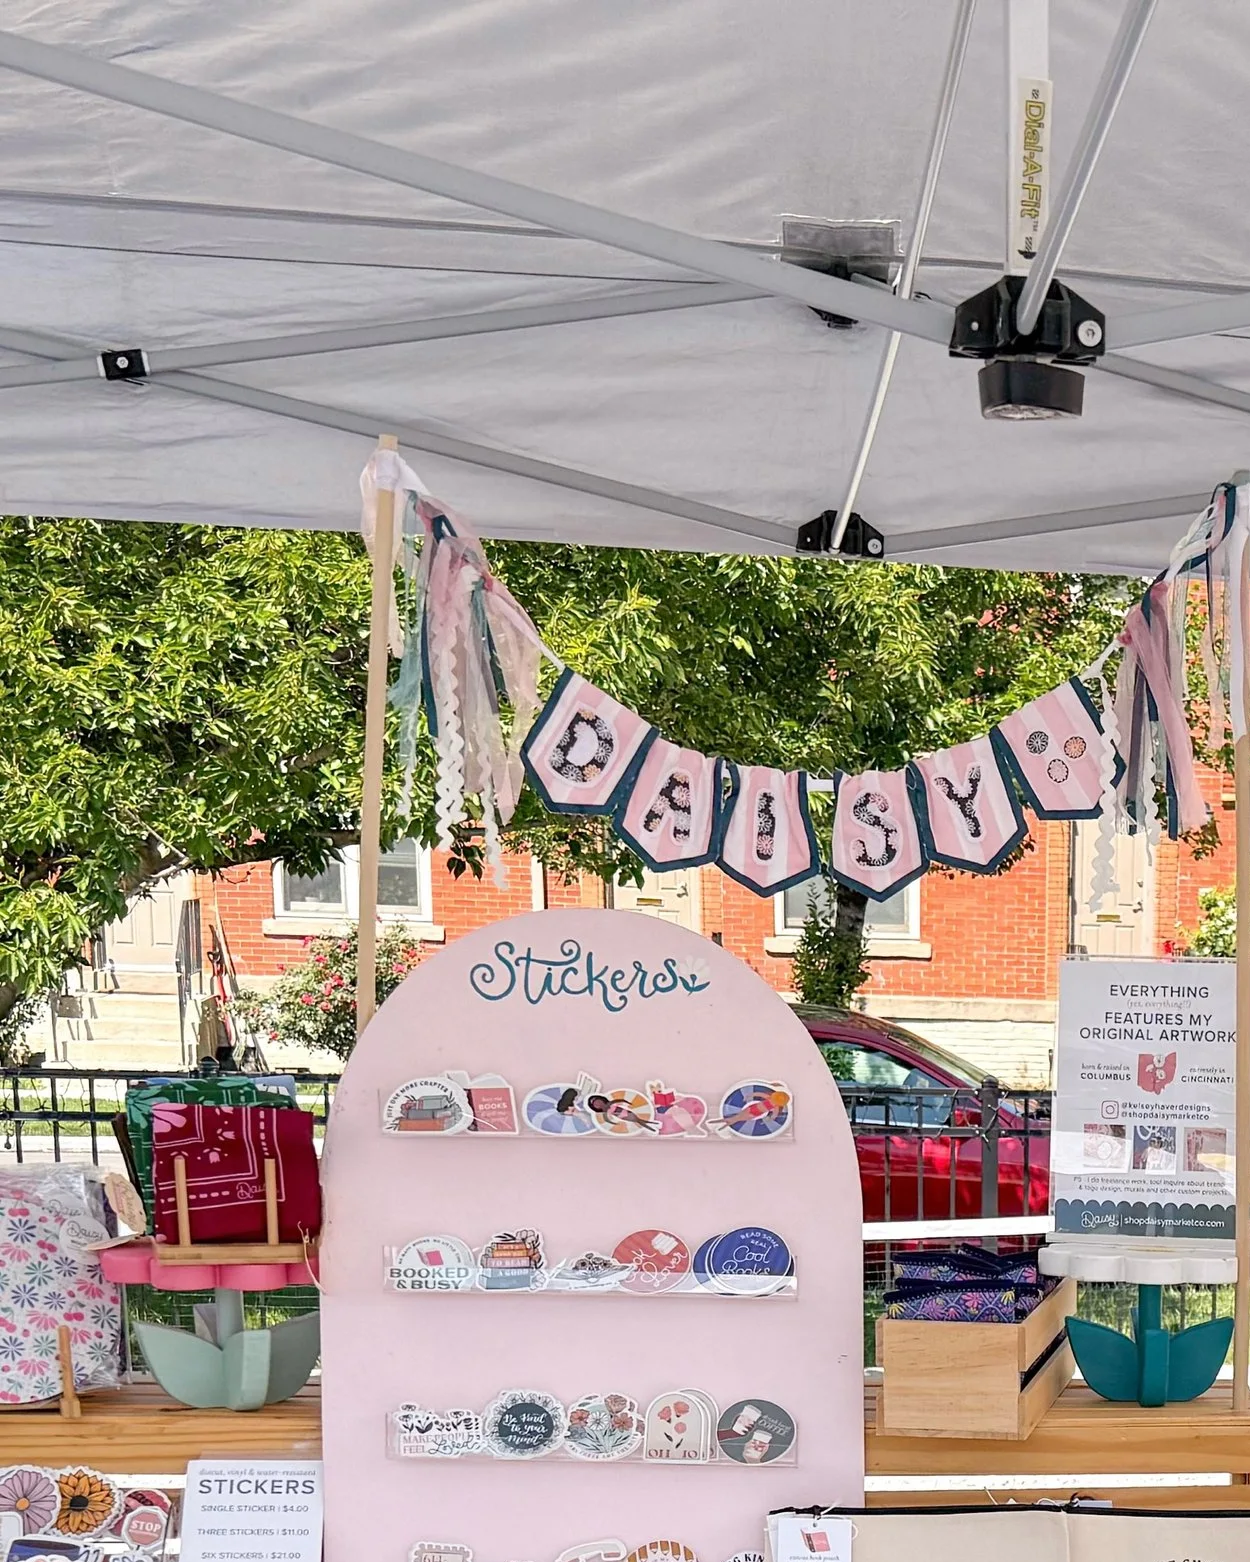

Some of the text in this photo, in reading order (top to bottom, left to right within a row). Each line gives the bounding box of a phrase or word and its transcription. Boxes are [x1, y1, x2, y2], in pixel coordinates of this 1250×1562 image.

[548, 706, 981, 868] DAISY
[470, 939, 708, 1012] Stickers
[1110, 984, 1209, 998] EVERYTHING
[1105, 1012, 1212, 1026] FEATURES MY
[1079, 1027, 1236, 1043] ORIGINAL ARTWORK
[1080, 1072, 1131, 1081] COLUMBUS
[1181, 1075, 1235, 1084] CINCINNATI
[1124, 1214, 1225, 1229] shopdaisymarketco.com
[733, 1245, 771, 1264] Cool
[390, 1267, 469, 1279] BOOKED
[396, 1279, 463, 1290] & BUSY
[403, 1435, 430, 1444] MAKE
[403, 1445, 425, 1454] FEEL
[198, 1479, 315, 1495] STICKERS
[200, 1504, 309, 1513] SINGLE STICKER $4.00
[131, 1520, 162, 1533] STOP
[197, 1528, 310, 1536] THREE STICKERS $11.00
[201, 1552, 301, 1560] SIX STICKERS $21.00
